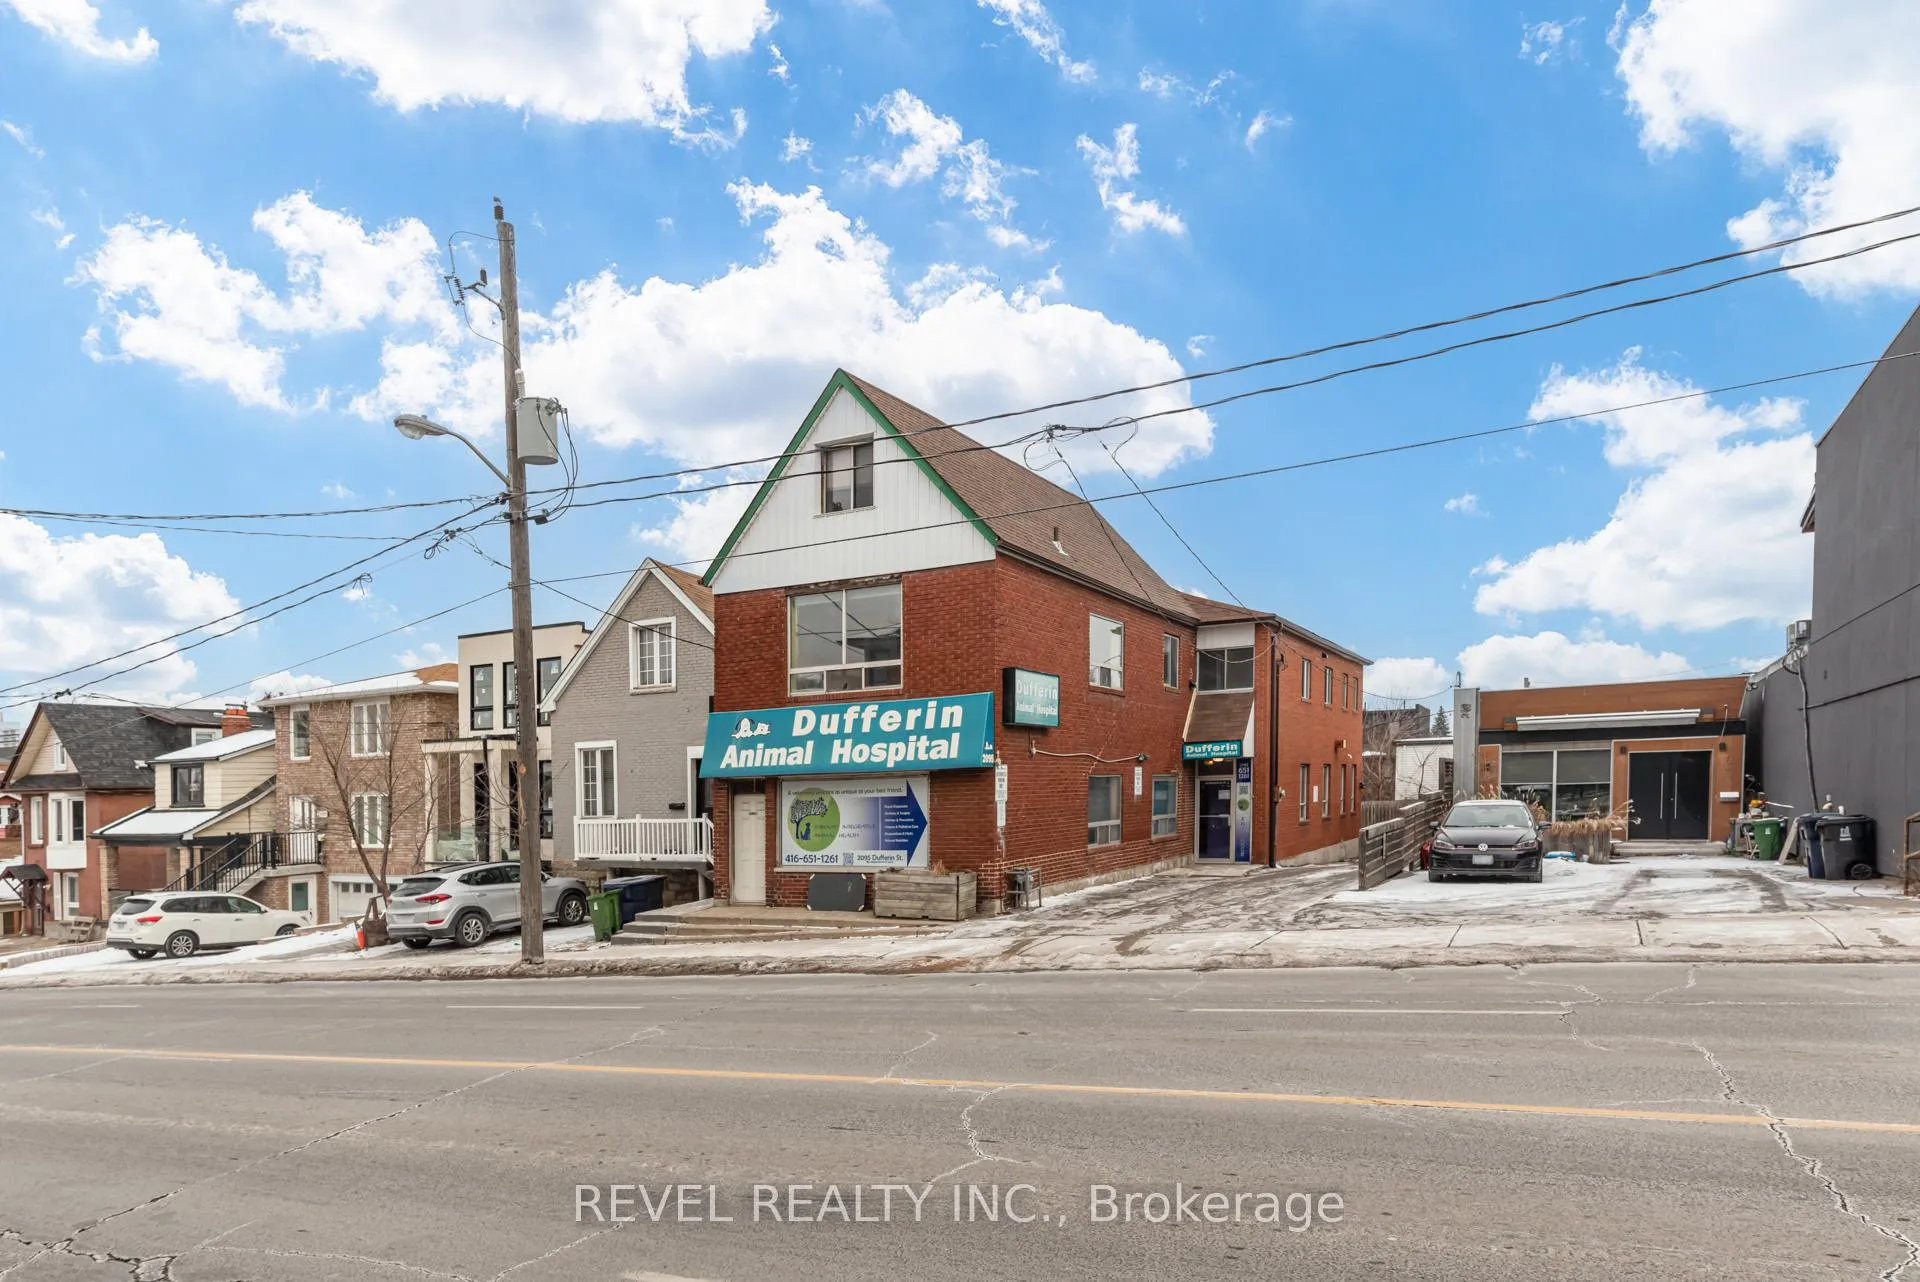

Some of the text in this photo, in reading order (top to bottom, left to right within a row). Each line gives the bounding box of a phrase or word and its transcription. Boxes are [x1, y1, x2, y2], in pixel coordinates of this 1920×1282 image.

[1016, 679, 1058, 700] Dufferin
[792, 700, 963, 737] Dufferin
[720, 732, 960, 769] Animal Hospital
[1185, 743, 1238, 753] Dufferin
[785, 854, 839, 864] 416-651-1261
